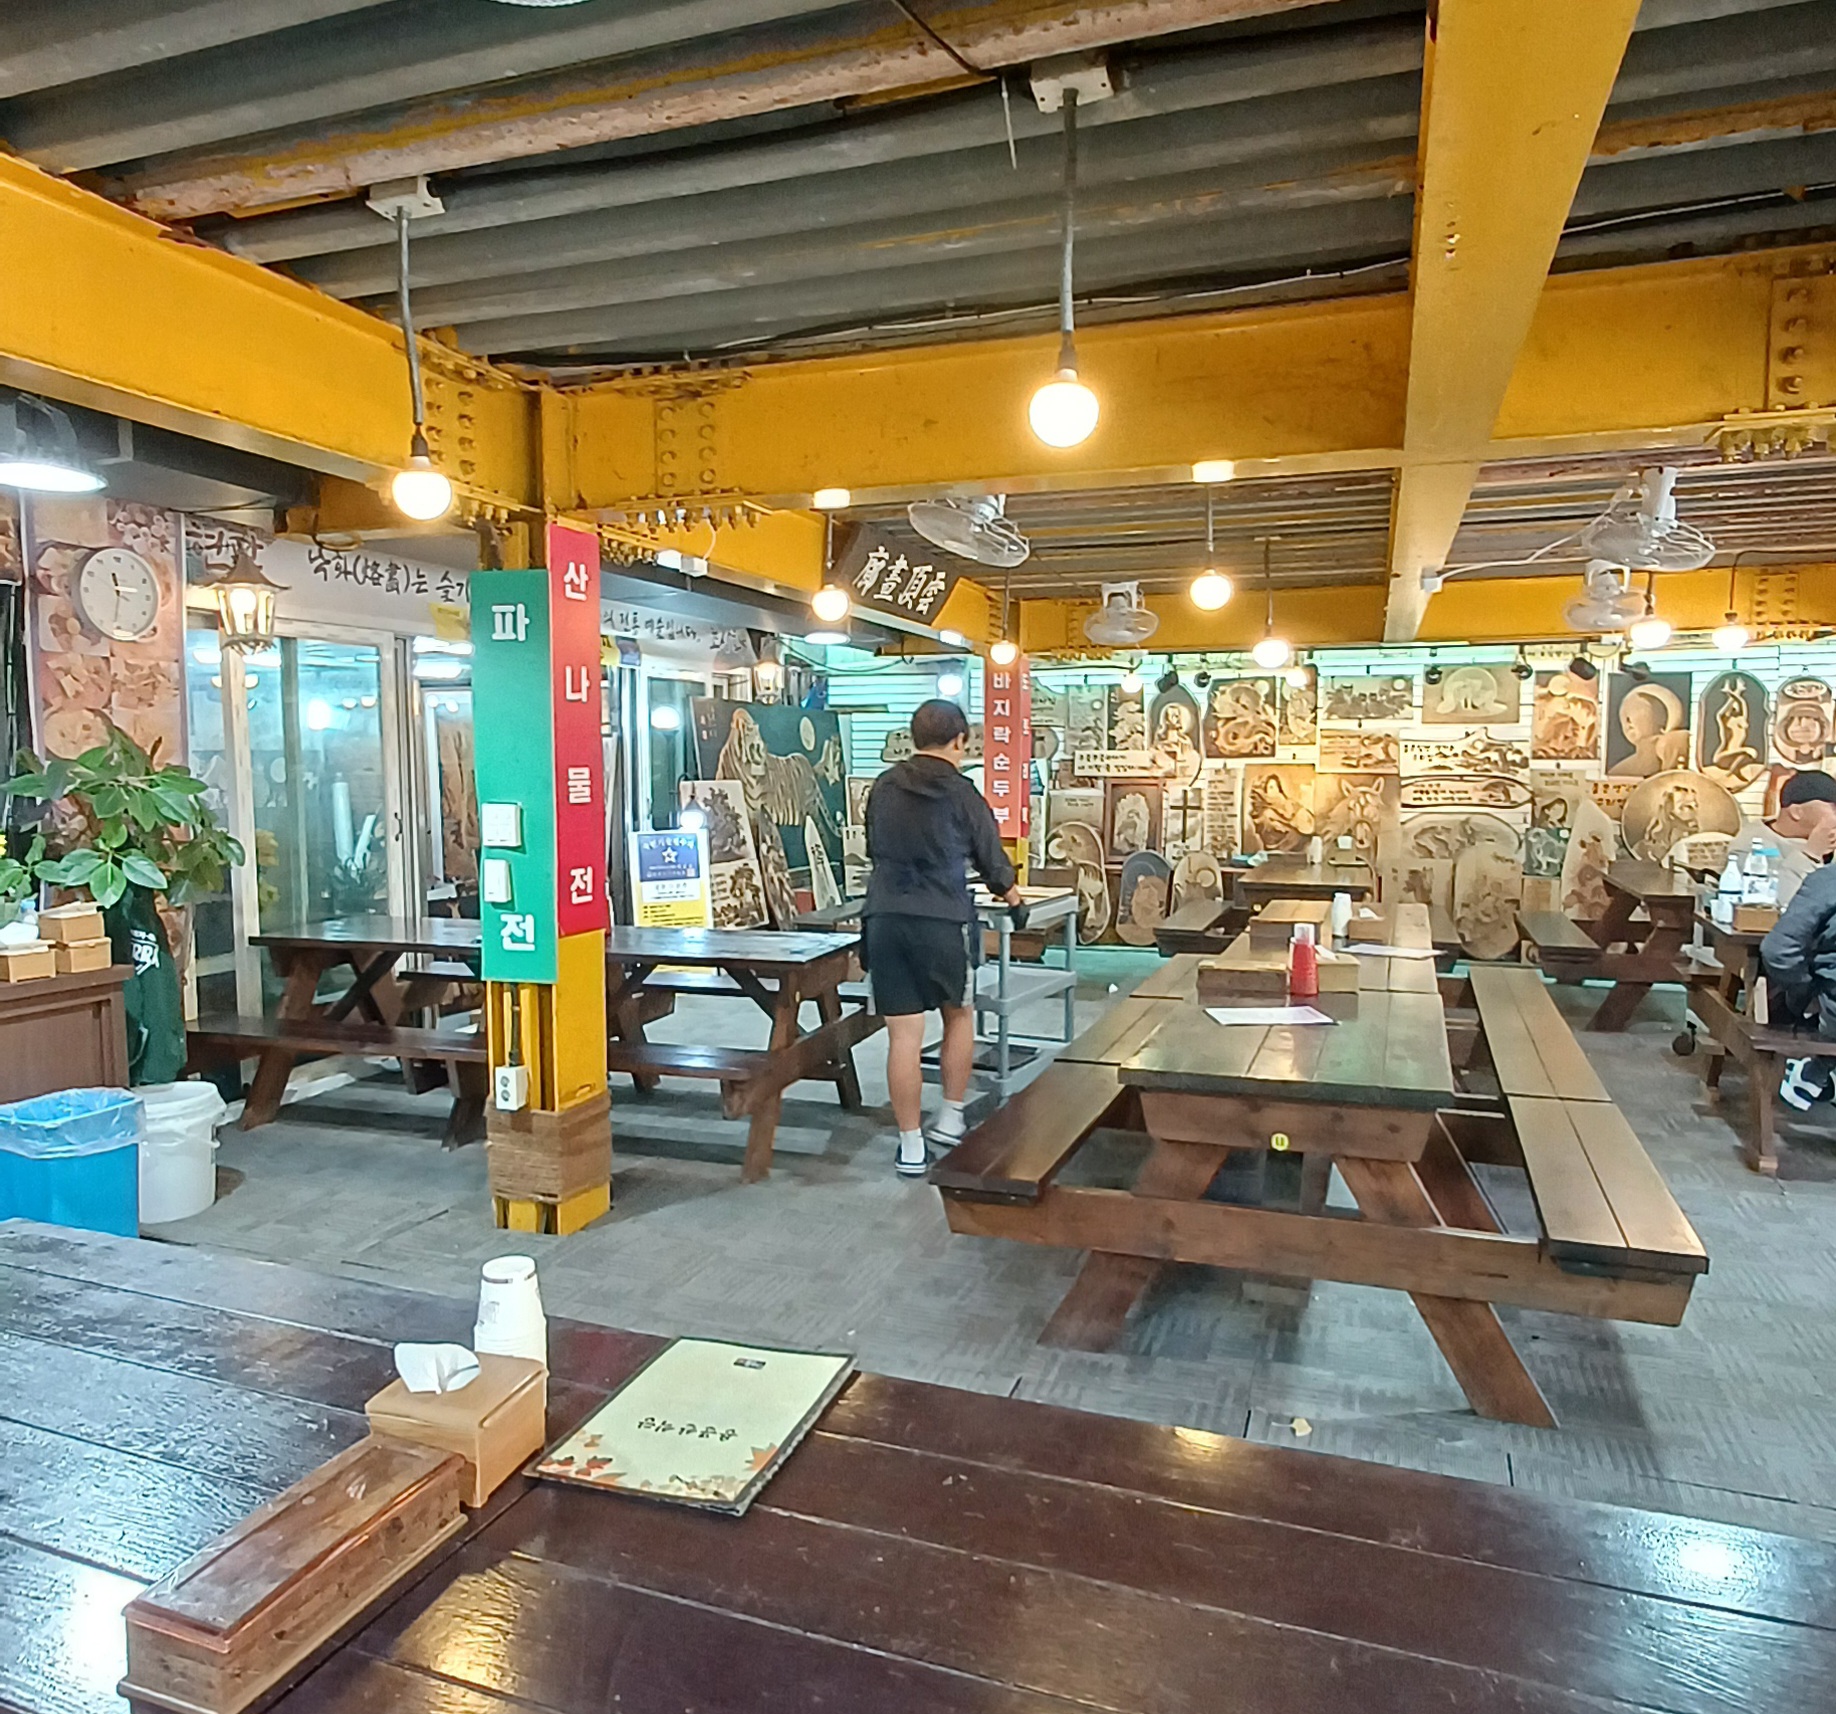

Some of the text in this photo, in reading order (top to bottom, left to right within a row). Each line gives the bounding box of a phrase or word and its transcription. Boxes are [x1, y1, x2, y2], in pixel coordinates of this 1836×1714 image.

[491, 604, 536, 952] 파전
[563, 562, 594, 905] 산나물전
[992, 672, 1011, 824] 바지락순두부
